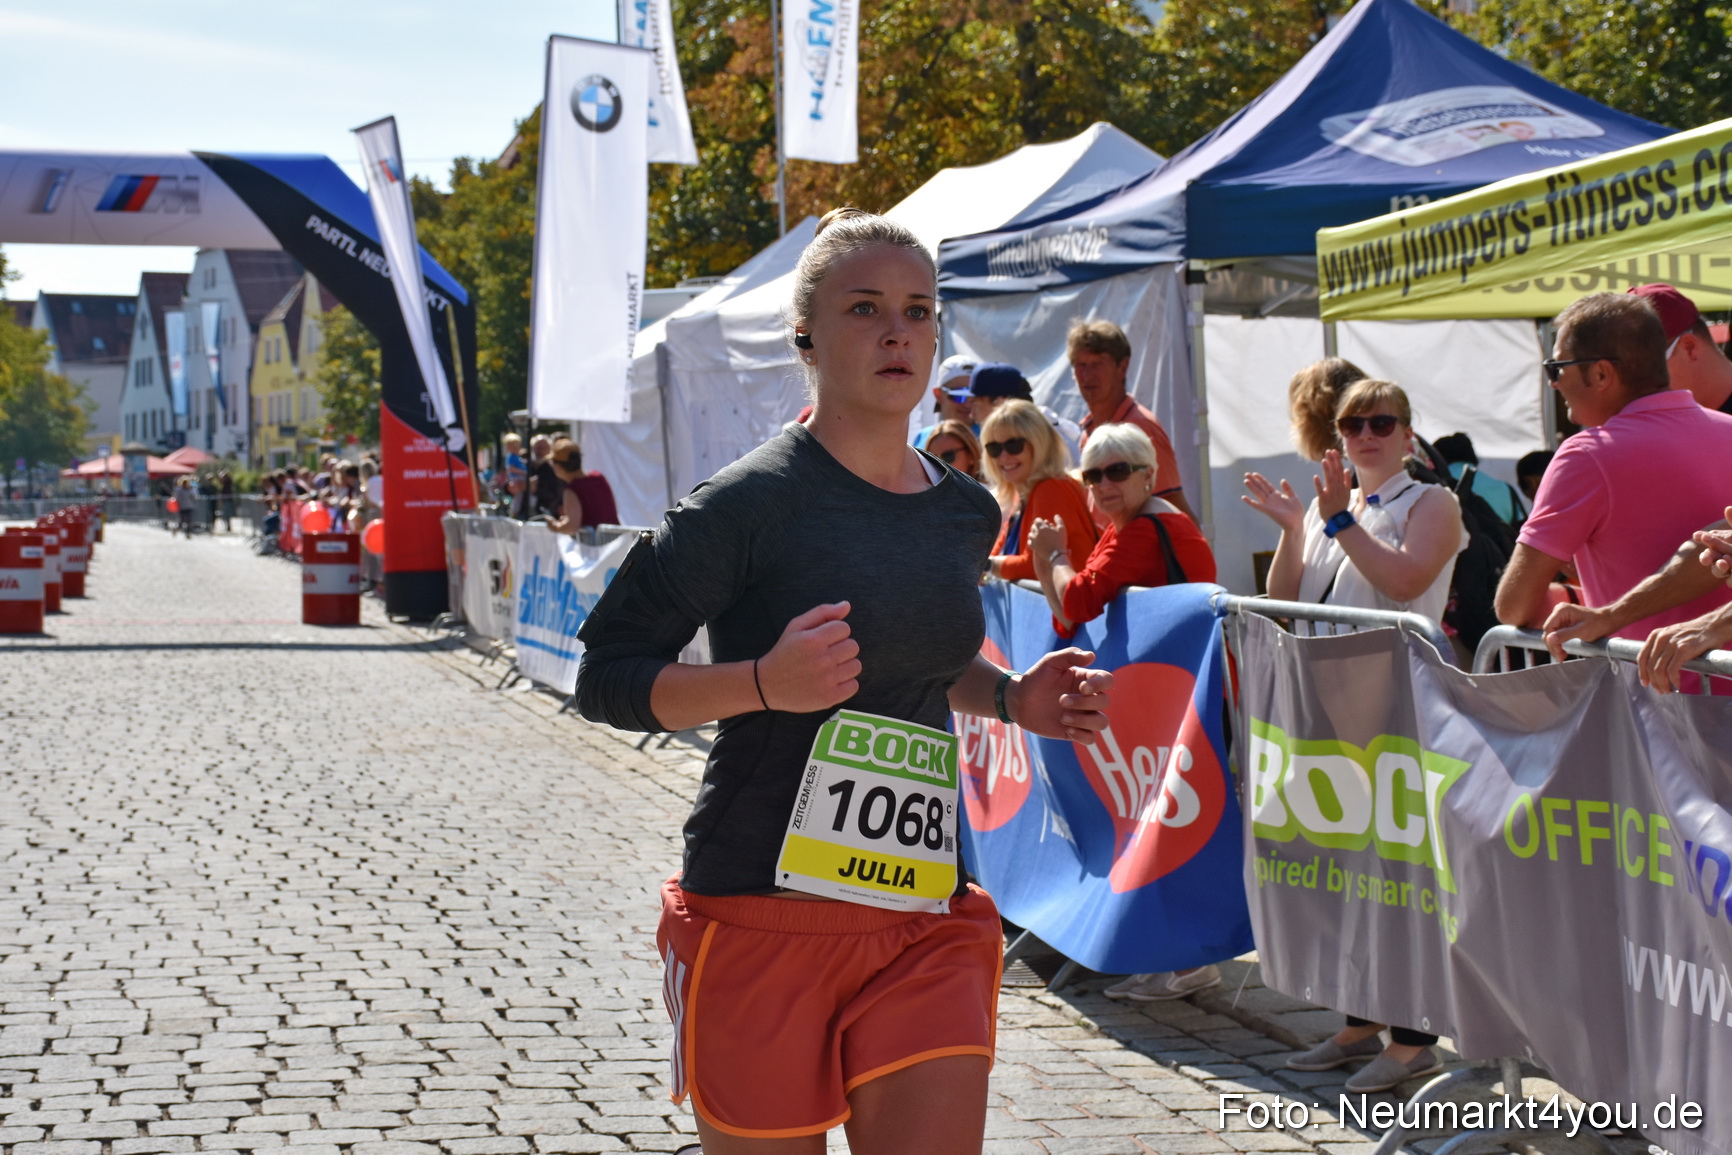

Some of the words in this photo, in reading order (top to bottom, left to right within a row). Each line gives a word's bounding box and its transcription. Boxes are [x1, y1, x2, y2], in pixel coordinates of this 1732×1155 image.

[305, 214, 357, 258] PARTL
[829, 720, 951, 781] BOCK
[953, 711, 1029, 795] ervis
[828, 779, 944, 850] 1068
[946, 804, 952, 815] C
[1504, 793, 1674, 887] OFFICE
[838, 857, 916, 889] JULIA
[1327, 858, 1354, 902] by
